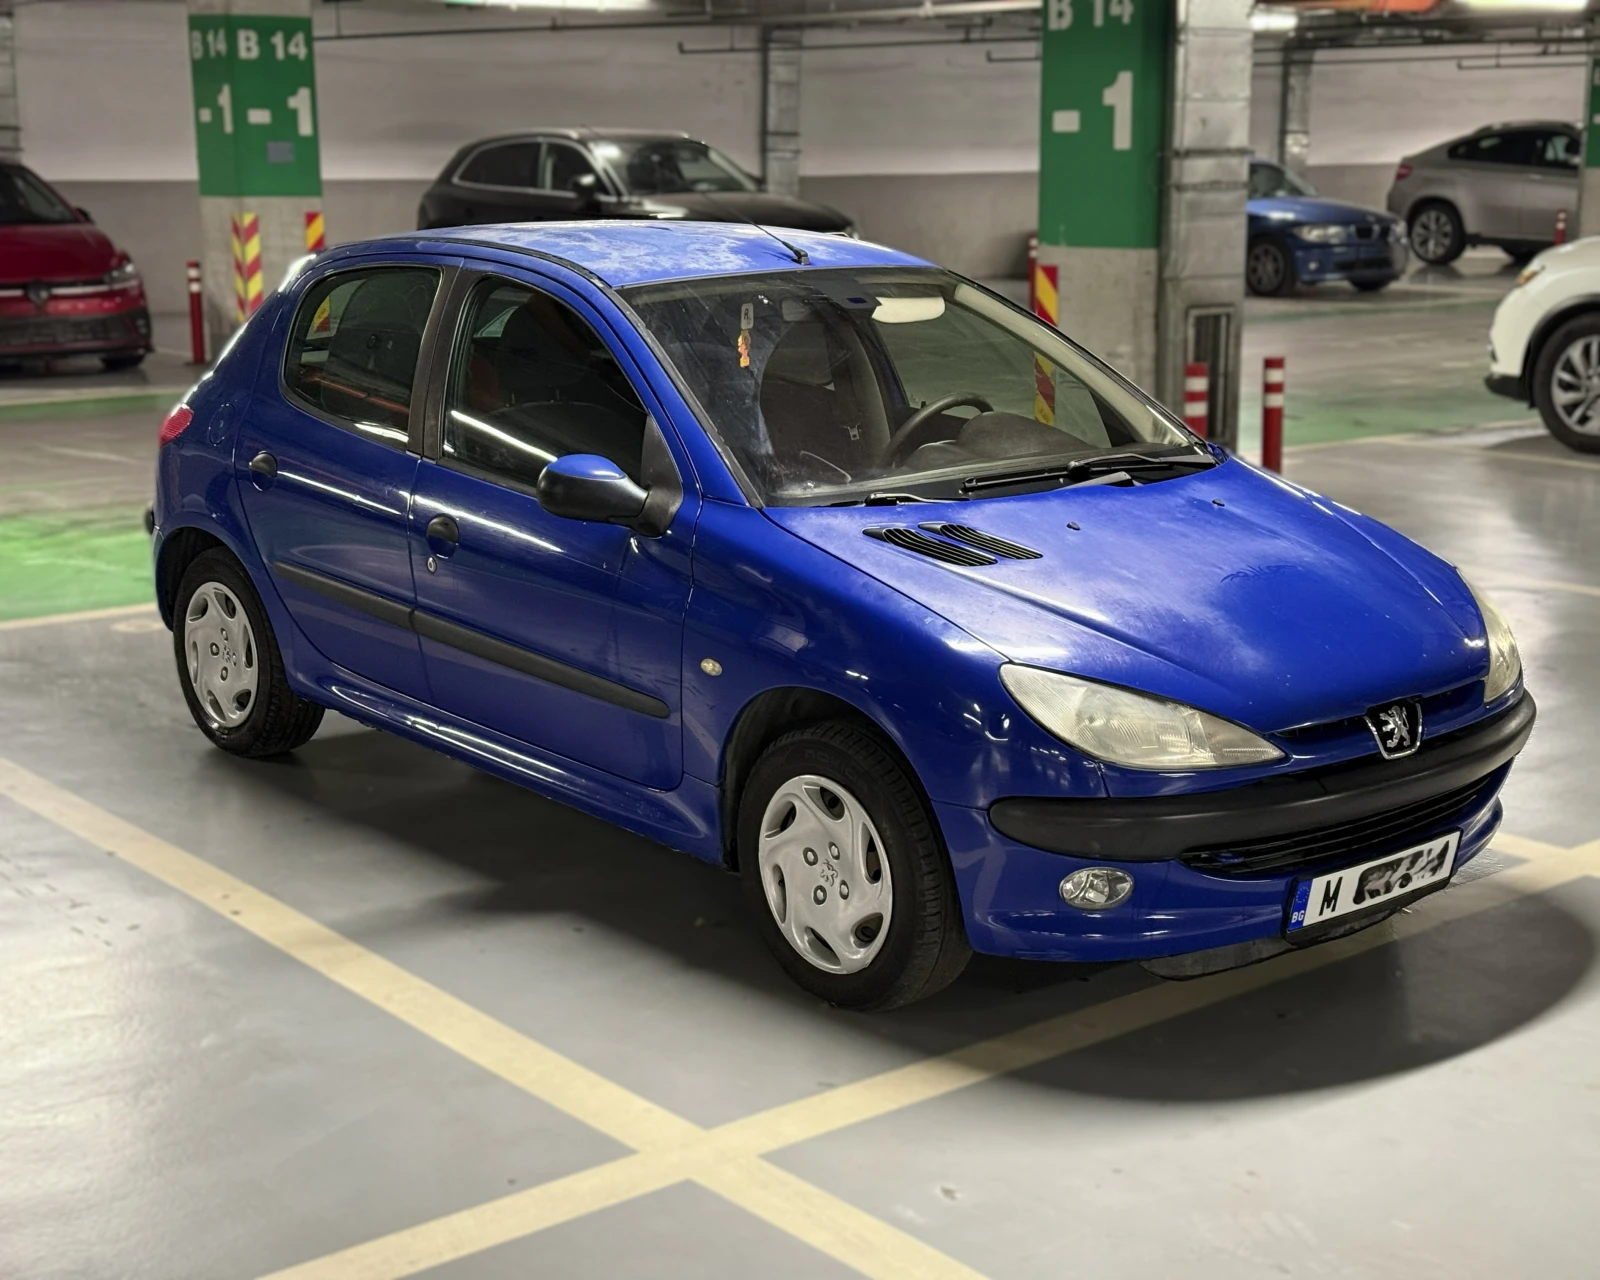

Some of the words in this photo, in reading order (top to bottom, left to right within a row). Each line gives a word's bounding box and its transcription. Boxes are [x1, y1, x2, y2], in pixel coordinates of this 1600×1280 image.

[1048, 0, 1073, 31] B
[190, 30, 204, 60] B
[206, 28, 227, 58] 14
[237, 29, 260, 60] B
[270, 30, 307, 61] 14
[1319, 876, 1343, 916] M
[1291, 910, 1305, 923] BG
